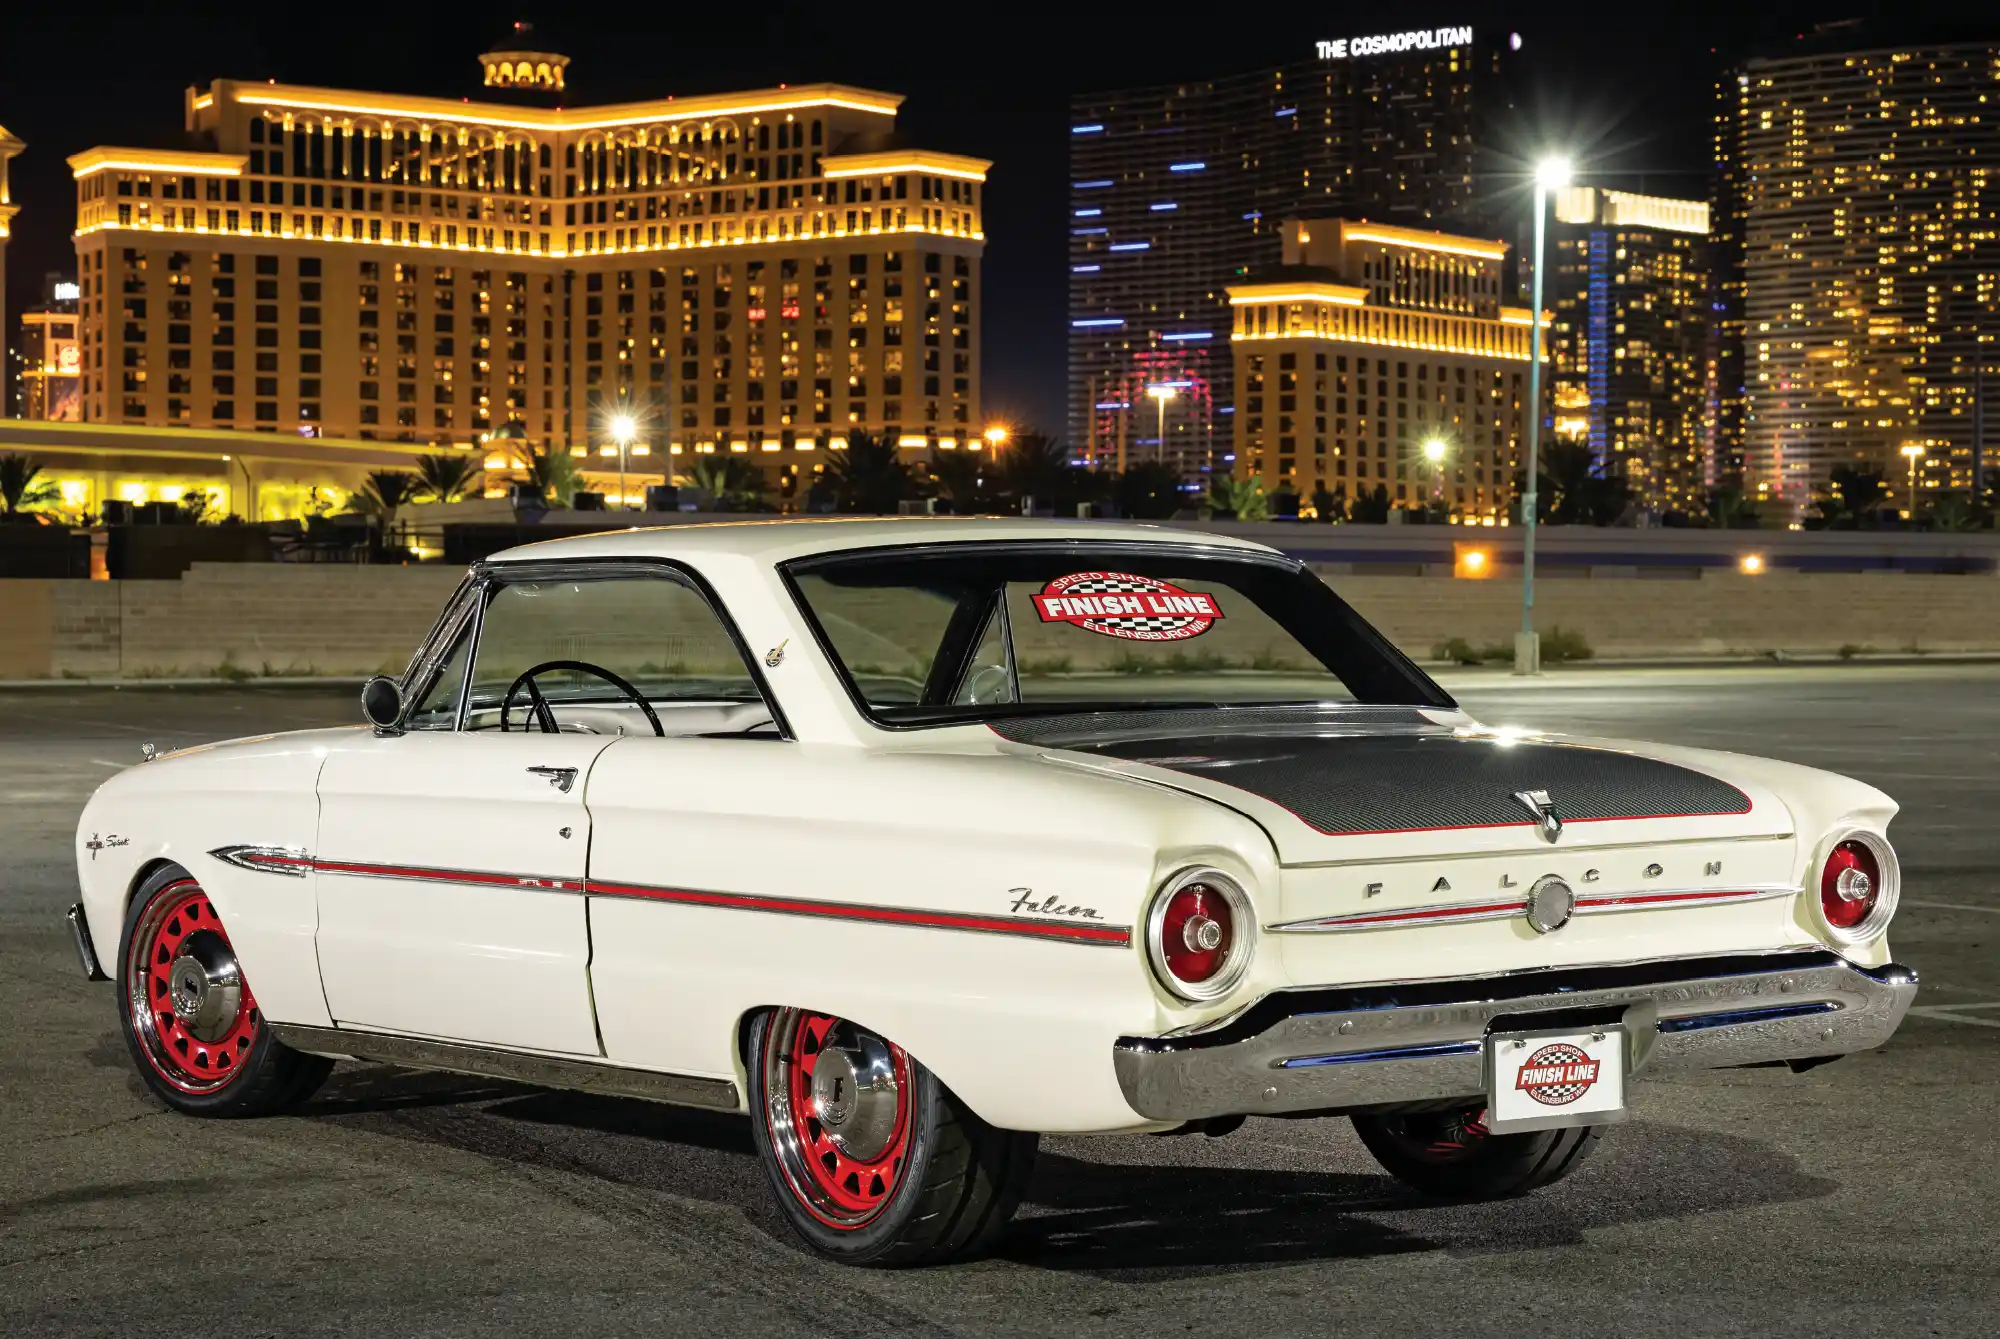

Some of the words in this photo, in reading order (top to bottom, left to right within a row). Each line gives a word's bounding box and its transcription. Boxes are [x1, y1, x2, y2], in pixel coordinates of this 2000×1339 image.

[1316, 40, 1347, 59] THE
[1351, 27, 1472, 56] COSMOPOLITAN
[1052, 572, 1102, 589] SPEED
[1107, 572, 1165, 587] SHOP
[1042, 596, 1145, 617] FINISH
[1146, 596, 1214, 615] LINE
[1083, 621, 1190, 640] ELLENSBURG
[1366, 861, 1721, 898] FALCON
[1008, 887, 1104, 919] Falcon
[1532, 1045, 1559, 1061] SPEED
[1560, 1045, 1583, 1057] SHOP
[1520, 1067, 1565, 1085] FINISH
[1566, 1063, 1596, 1081] LINE
[1530, 1088, 1575, 1104] ELLENSBURG
